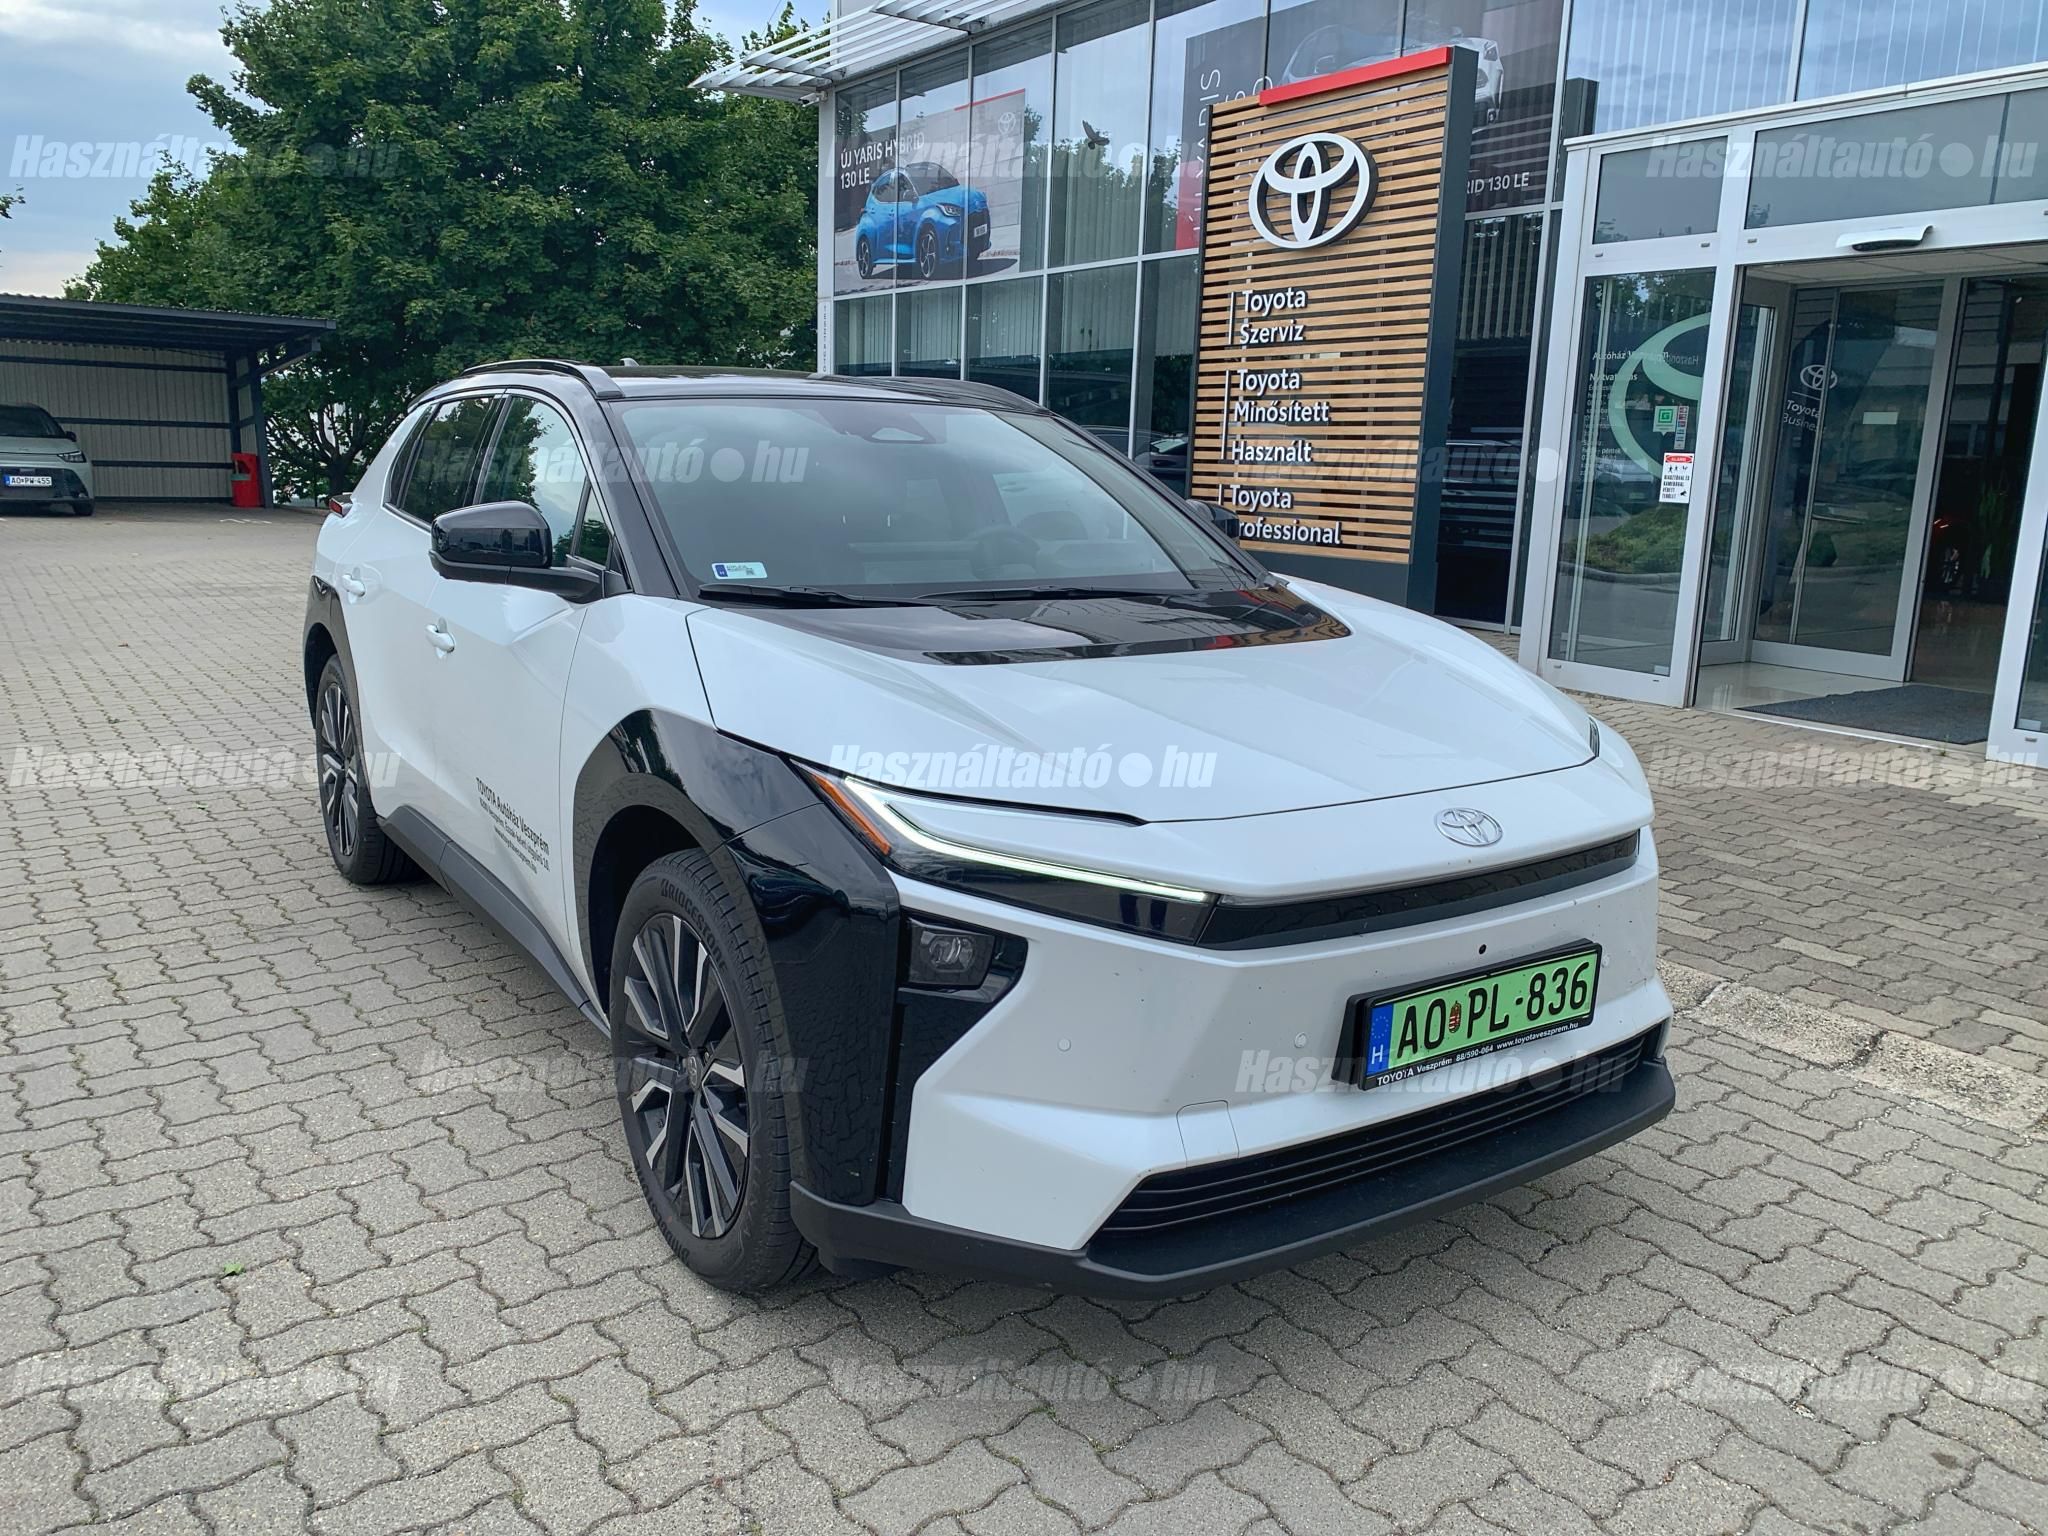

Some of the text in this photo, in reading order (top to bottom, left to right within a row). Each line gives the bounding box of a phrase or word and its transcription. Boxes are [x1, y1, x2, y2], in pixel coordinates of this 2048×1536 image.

[841, 132, 924, 168] ÚJ YARIS HYBRID
[841, 167, 870, 189] 130 LE
[1488, 175, 1510, 191] 130
[1513, 172, 1530, 188] LE
[1242, 287, 1307, 316] Toyota
[1239, 319, 1305, 344] Szerviz
[1237, 368, 1300, 396] Toyota
[1234, 400, 1330, 422] Minősített
[1231, 440, 1312, 462] Használt
[1229, 484, 1292, 512] Toyota
[1239, 517, 1340, 544] rofessional
[660, 878, 728, 975] BRIDGESTONE
[1376, 1068, 1415, 1087] TOYOTA
[1416, 1058, 1453, 1075] Veszprém
[1496, 1021, 1579, 1050] www.toyotaveszprem.hu
